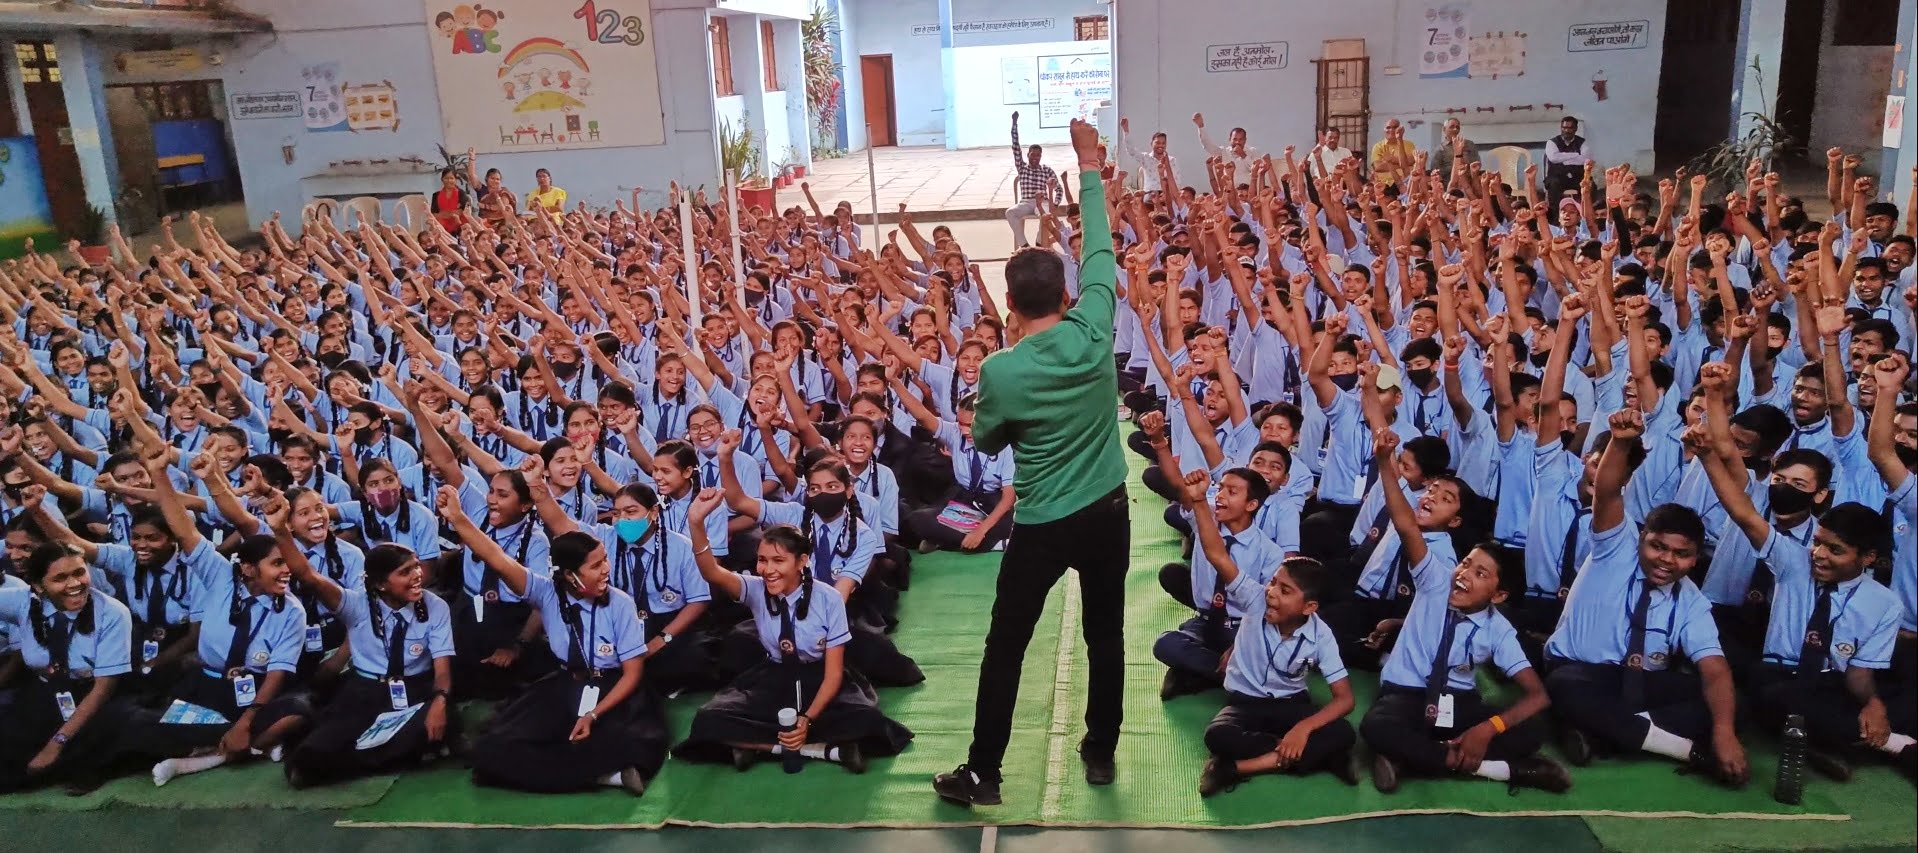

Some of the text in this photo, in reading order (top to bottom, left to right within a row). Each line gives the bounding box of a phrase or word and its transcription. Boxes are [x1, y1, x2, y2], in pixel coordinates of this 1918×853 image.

[573, 0, 645, 46] 123
[452, 29, 502, 54] ABC
[1427, 28, 1438, 46] 7
[1216, 48, 1231, 57] जल
[1233, 46, 1240, 57] है
[306, 86, 315, 102] 7
